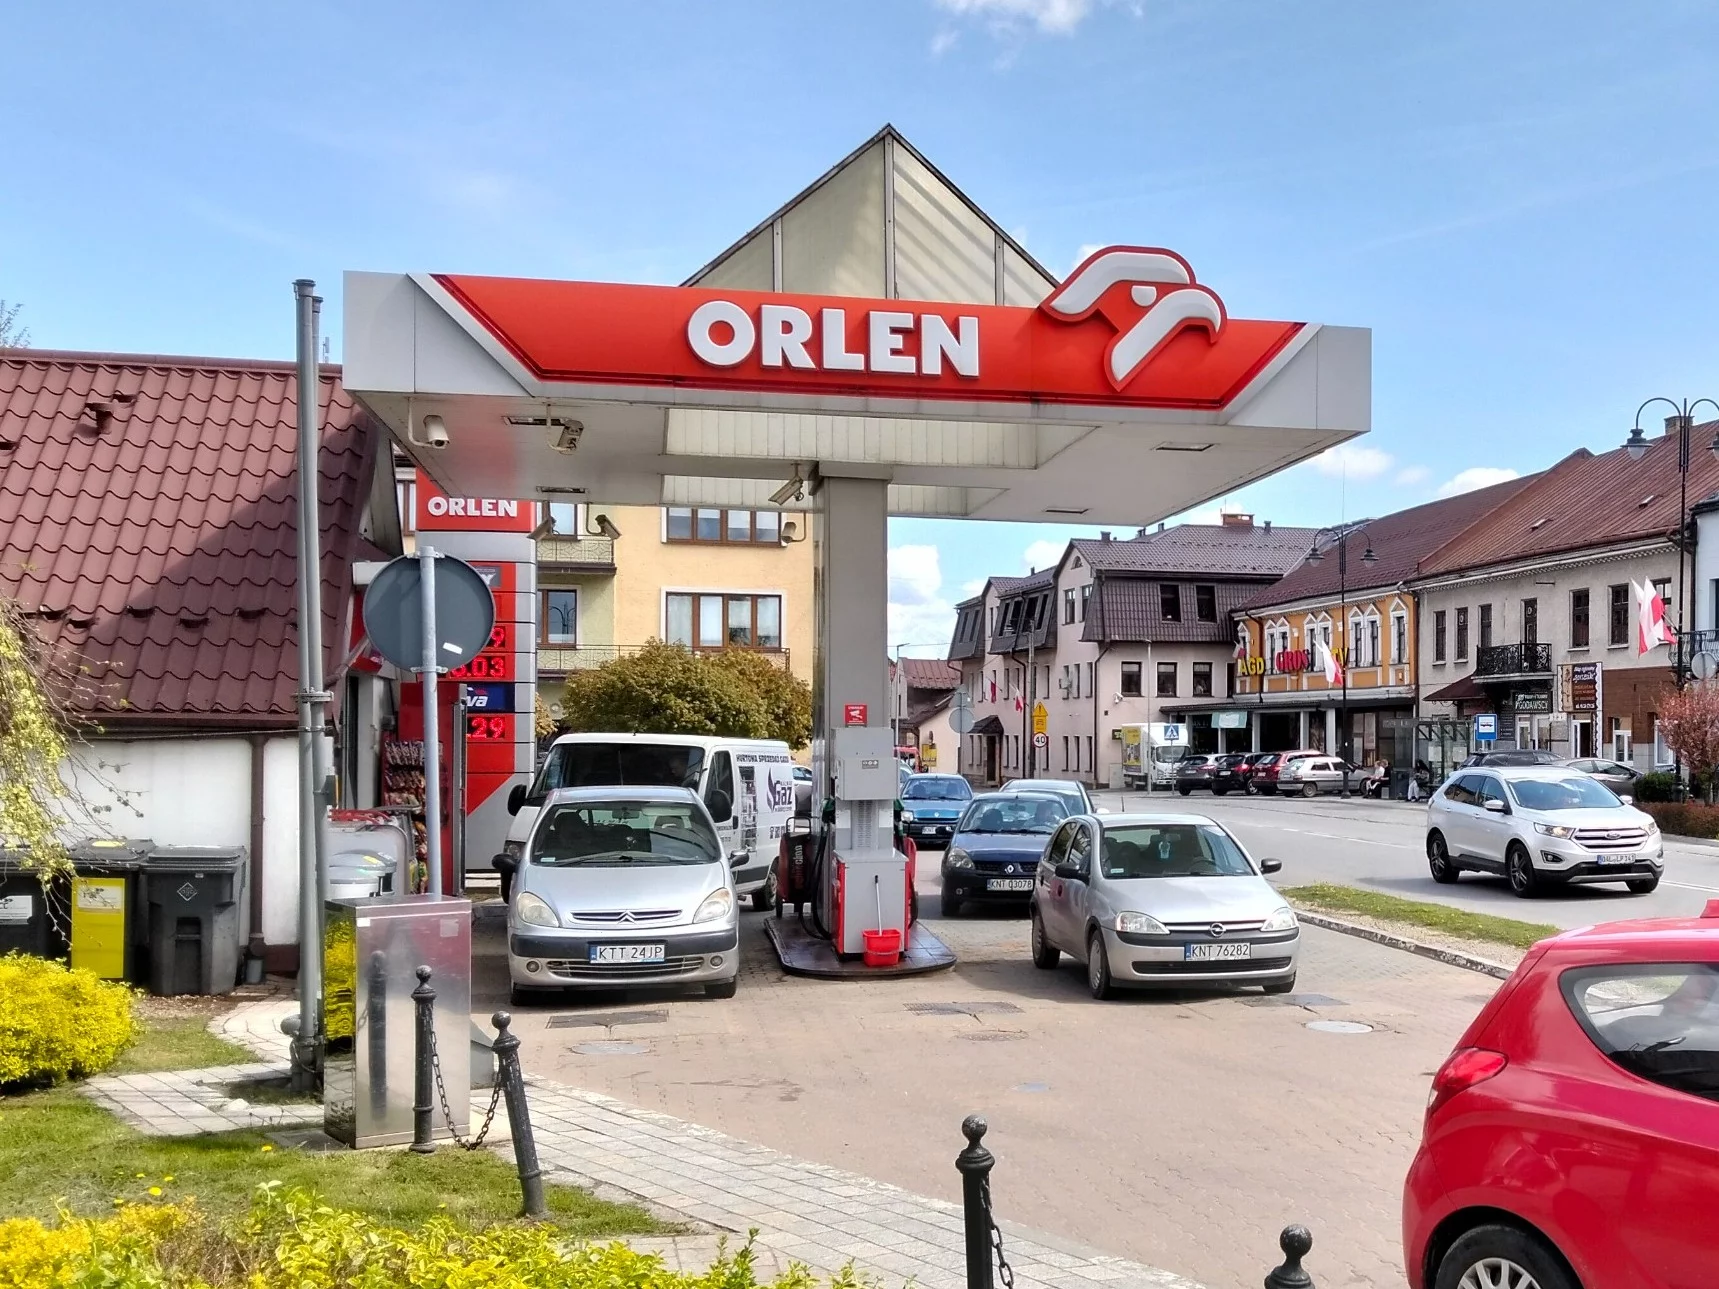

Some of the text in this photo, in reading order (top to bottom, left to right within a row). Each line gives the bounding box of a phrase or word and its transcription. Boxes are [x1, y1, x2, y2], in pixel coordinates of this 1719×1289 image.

[687, 300, 980, 377] ORLEN
[427, 496, 518, 517] ORLEN
[1237, 657, 1265, 675] AGD
[1275, 649, 1310, 672] GROS
[1035, 736, 1046, 744] 40
[991, 879, 1006, 889] KNT
[599, 946, 663, 959] KTT 24JP
[1192, 944, 1249, 958] KNT 76282
